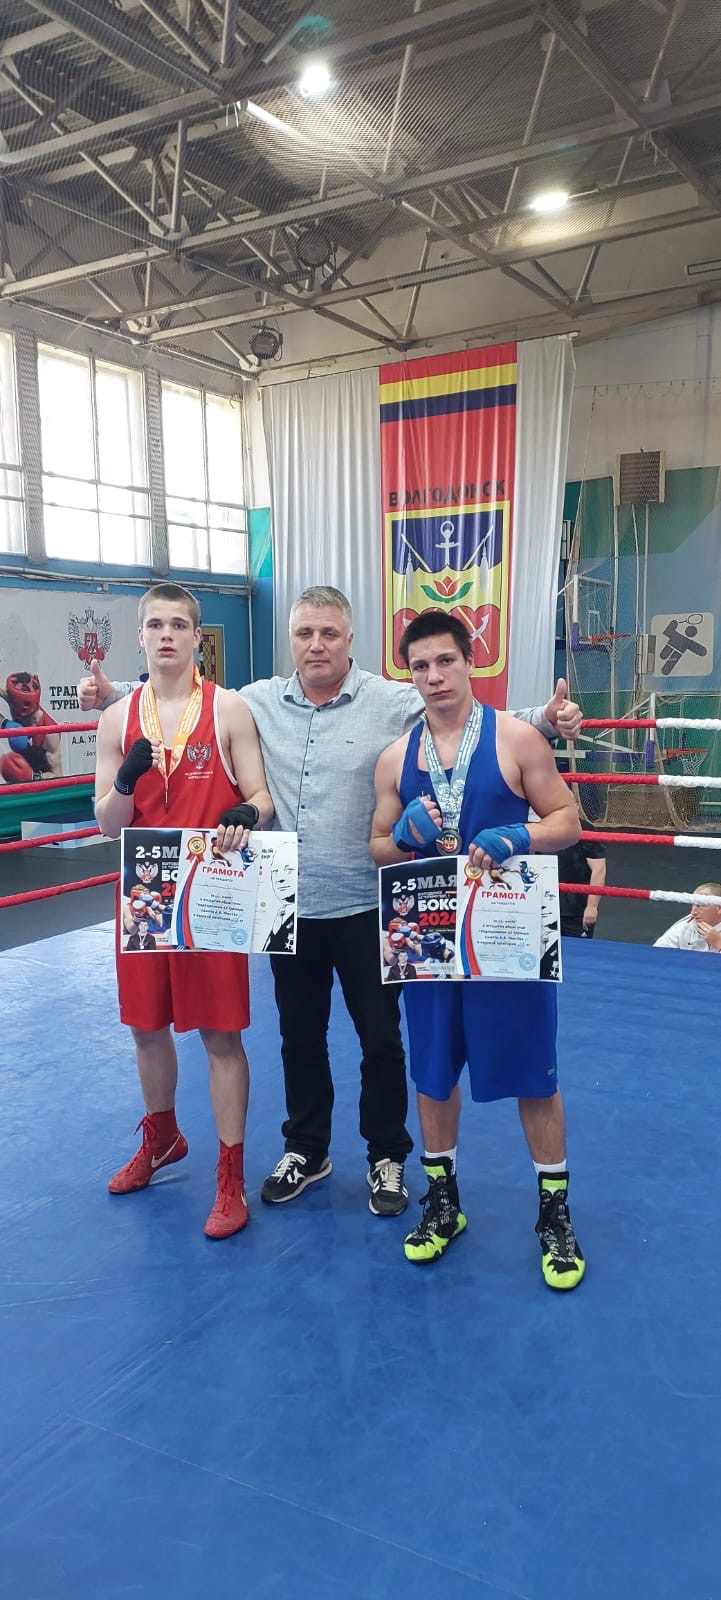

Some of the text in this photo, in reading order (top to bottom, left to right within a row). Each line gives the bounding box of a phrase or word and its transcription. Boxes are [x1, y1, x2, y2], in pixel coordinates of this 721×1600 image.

[388, 480, 505, 506] ВОЛГОДОНСК
[135, 845, 161, 859] 2-5
[202, 866, 244, 878] ГРАМОТА
[391, 874, 457, 894] 2-5 МАЯ
[481, 891, 526, 900] ГРАМОТА
